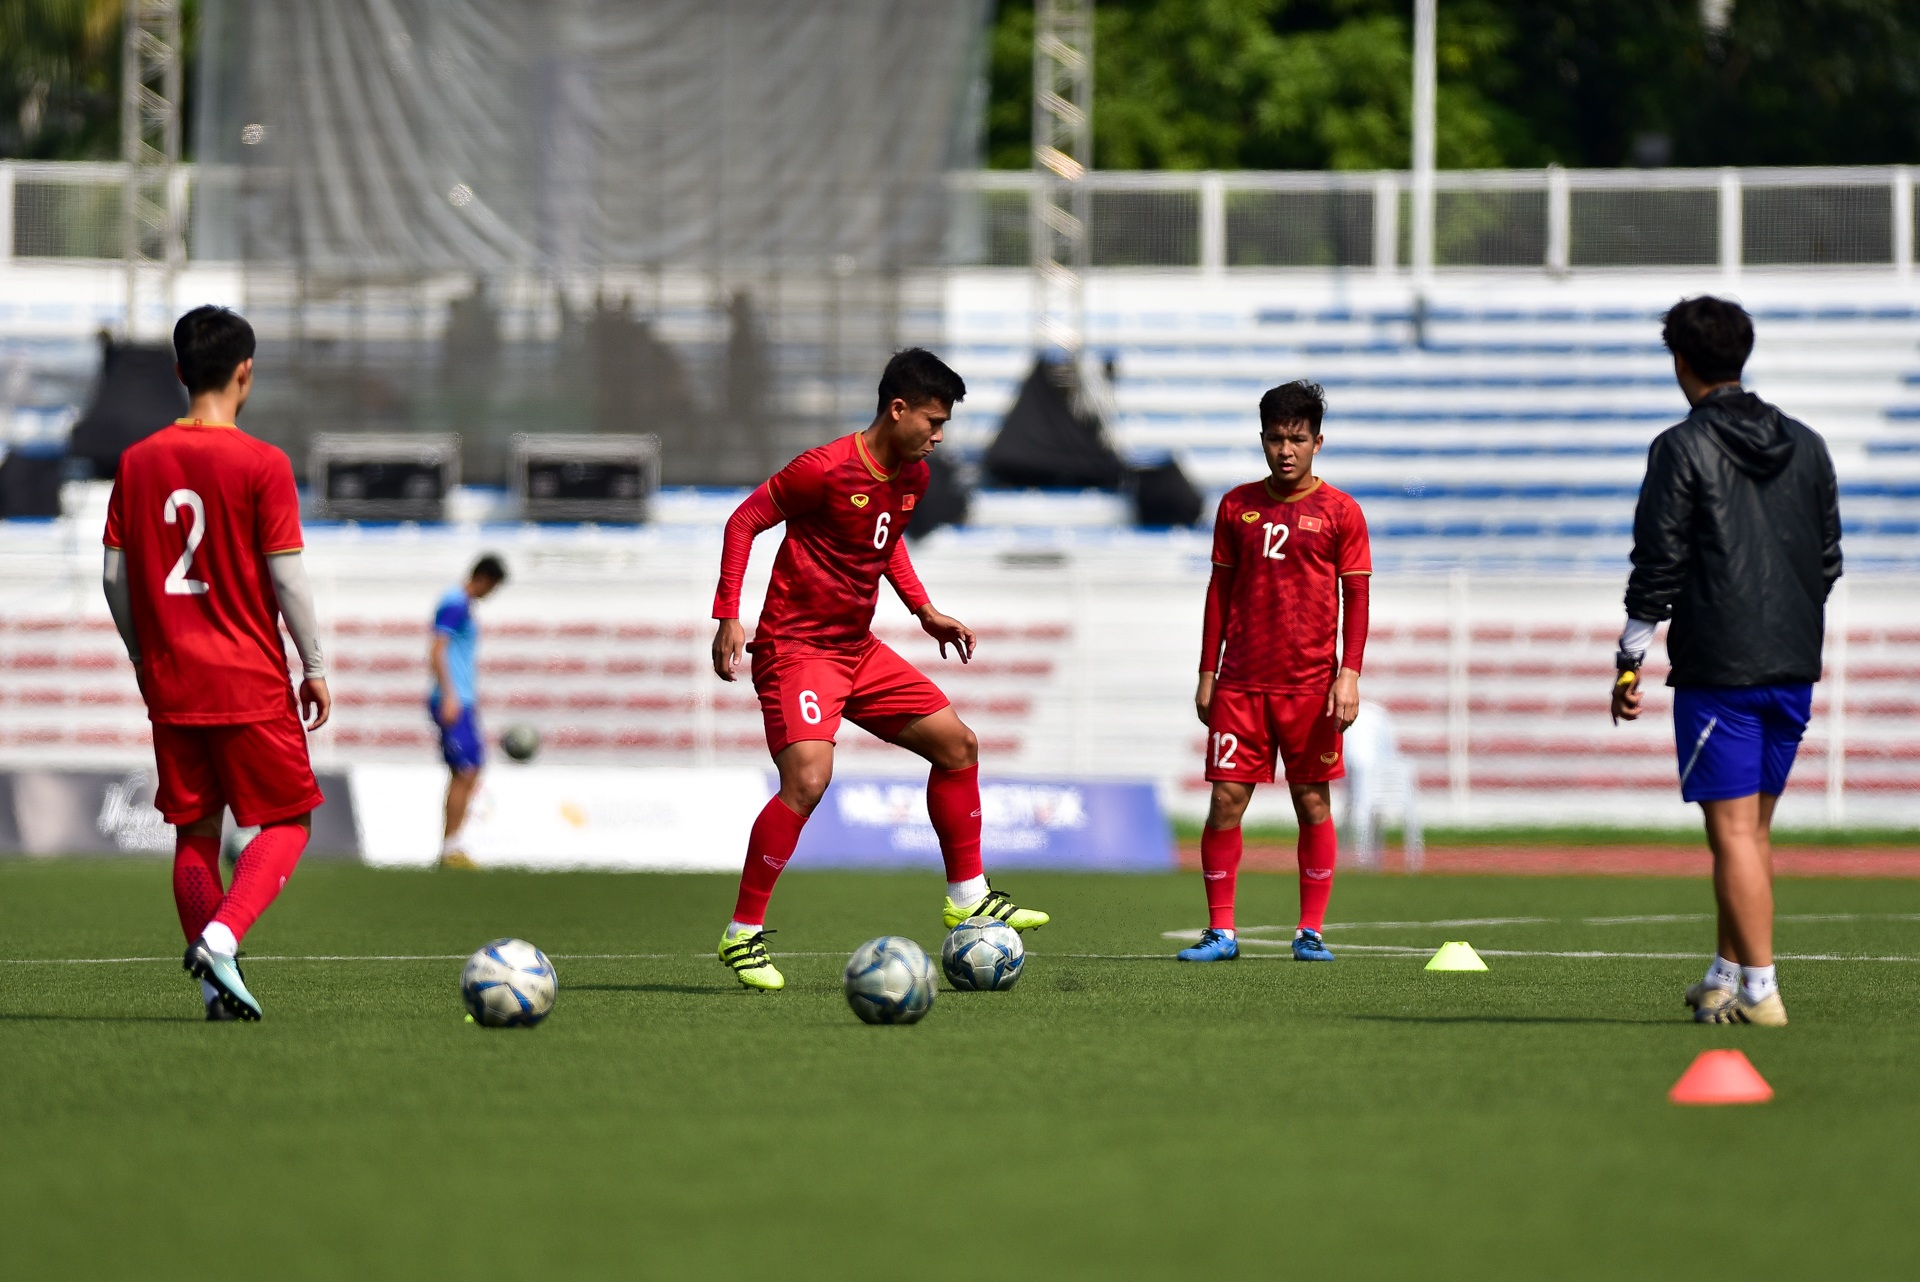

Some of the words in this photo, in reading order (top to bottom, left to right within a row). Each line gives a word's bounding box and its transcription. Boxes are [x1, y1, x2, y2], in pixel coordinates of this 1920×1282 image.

[164, 488, 210, 596] 2
[873, 512, 891, 549] 6
[1262, 522, 1290, 560] 12
[799, 690, 822, 725] 6
[1212, 731, 1238, 769] 12
